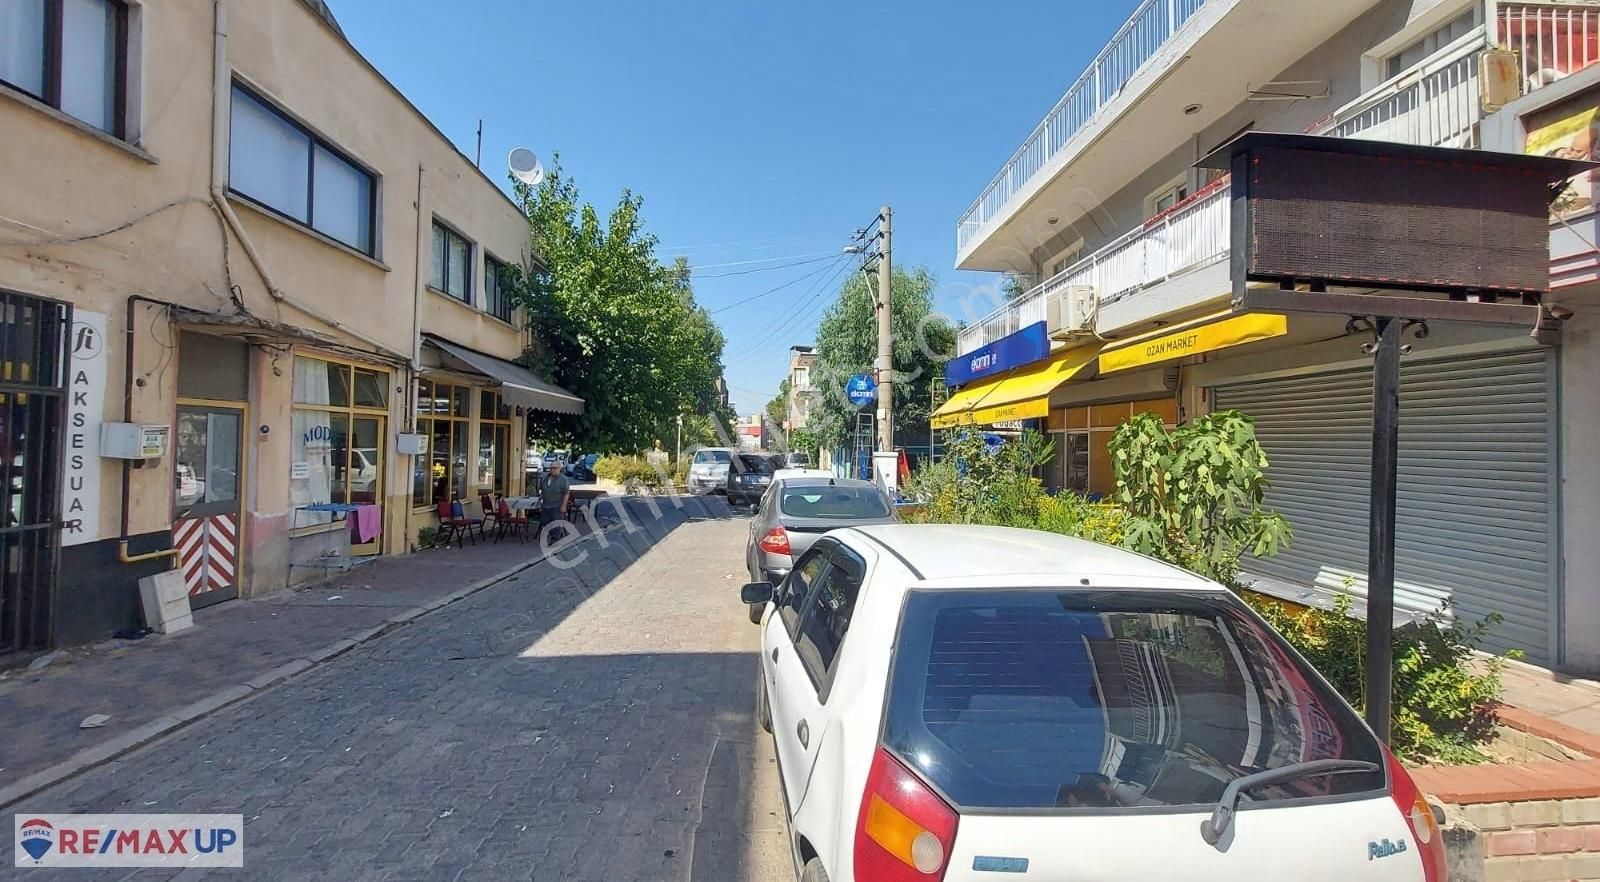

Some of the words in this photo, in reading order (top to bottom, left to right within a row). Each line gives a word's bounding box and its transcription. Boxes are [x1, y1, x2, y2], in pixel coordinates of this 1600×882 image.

[1147, 343, 1165, 356] OZAN
[1167, 335, 1198, 352] MARKET
[69, 370, 88, 534] AKSESUAR
